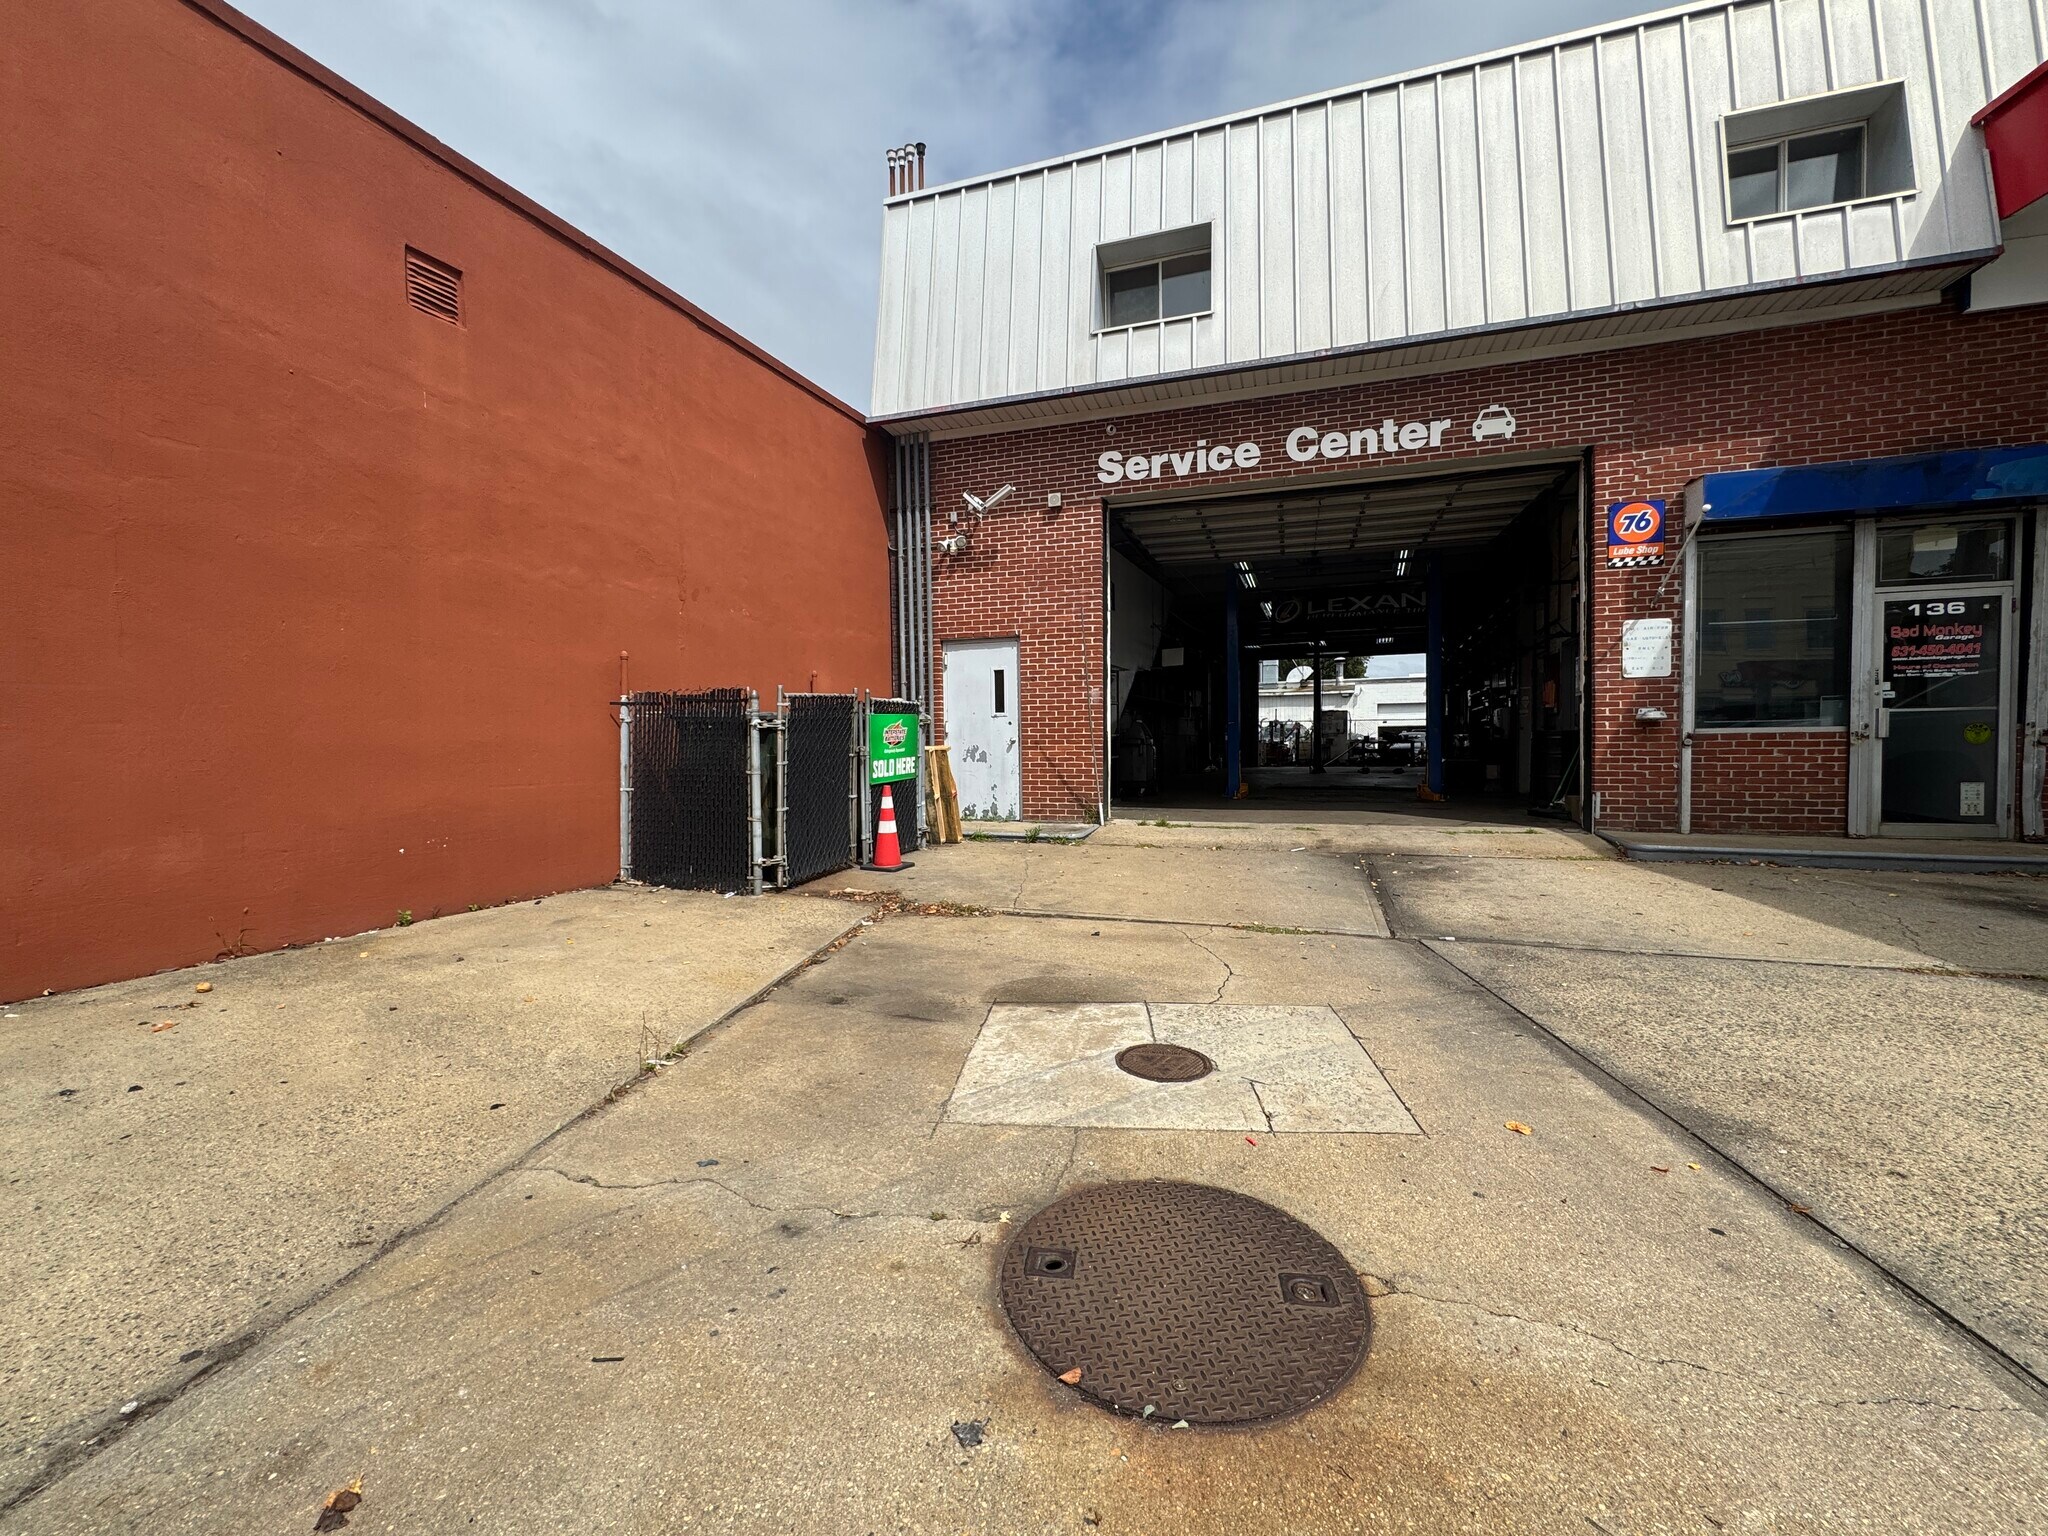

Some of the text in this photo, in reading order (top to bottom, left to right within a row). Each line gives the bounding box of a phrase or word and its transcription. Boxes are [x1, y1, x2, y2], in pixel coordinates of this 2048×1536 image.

[1097, 419, 1451, 484] Service Center
[1619, 510, 1653, 534] 76
[1613, 545, 1659, 556] Lube Shop
[1908, 601, 1966, 616] 136
[1890, 622, 1983, 638] Bad Monkey
[1891, 643, 1981, 657] 631-450-4041
[873, 756, 915, 778] SOLD HERE
